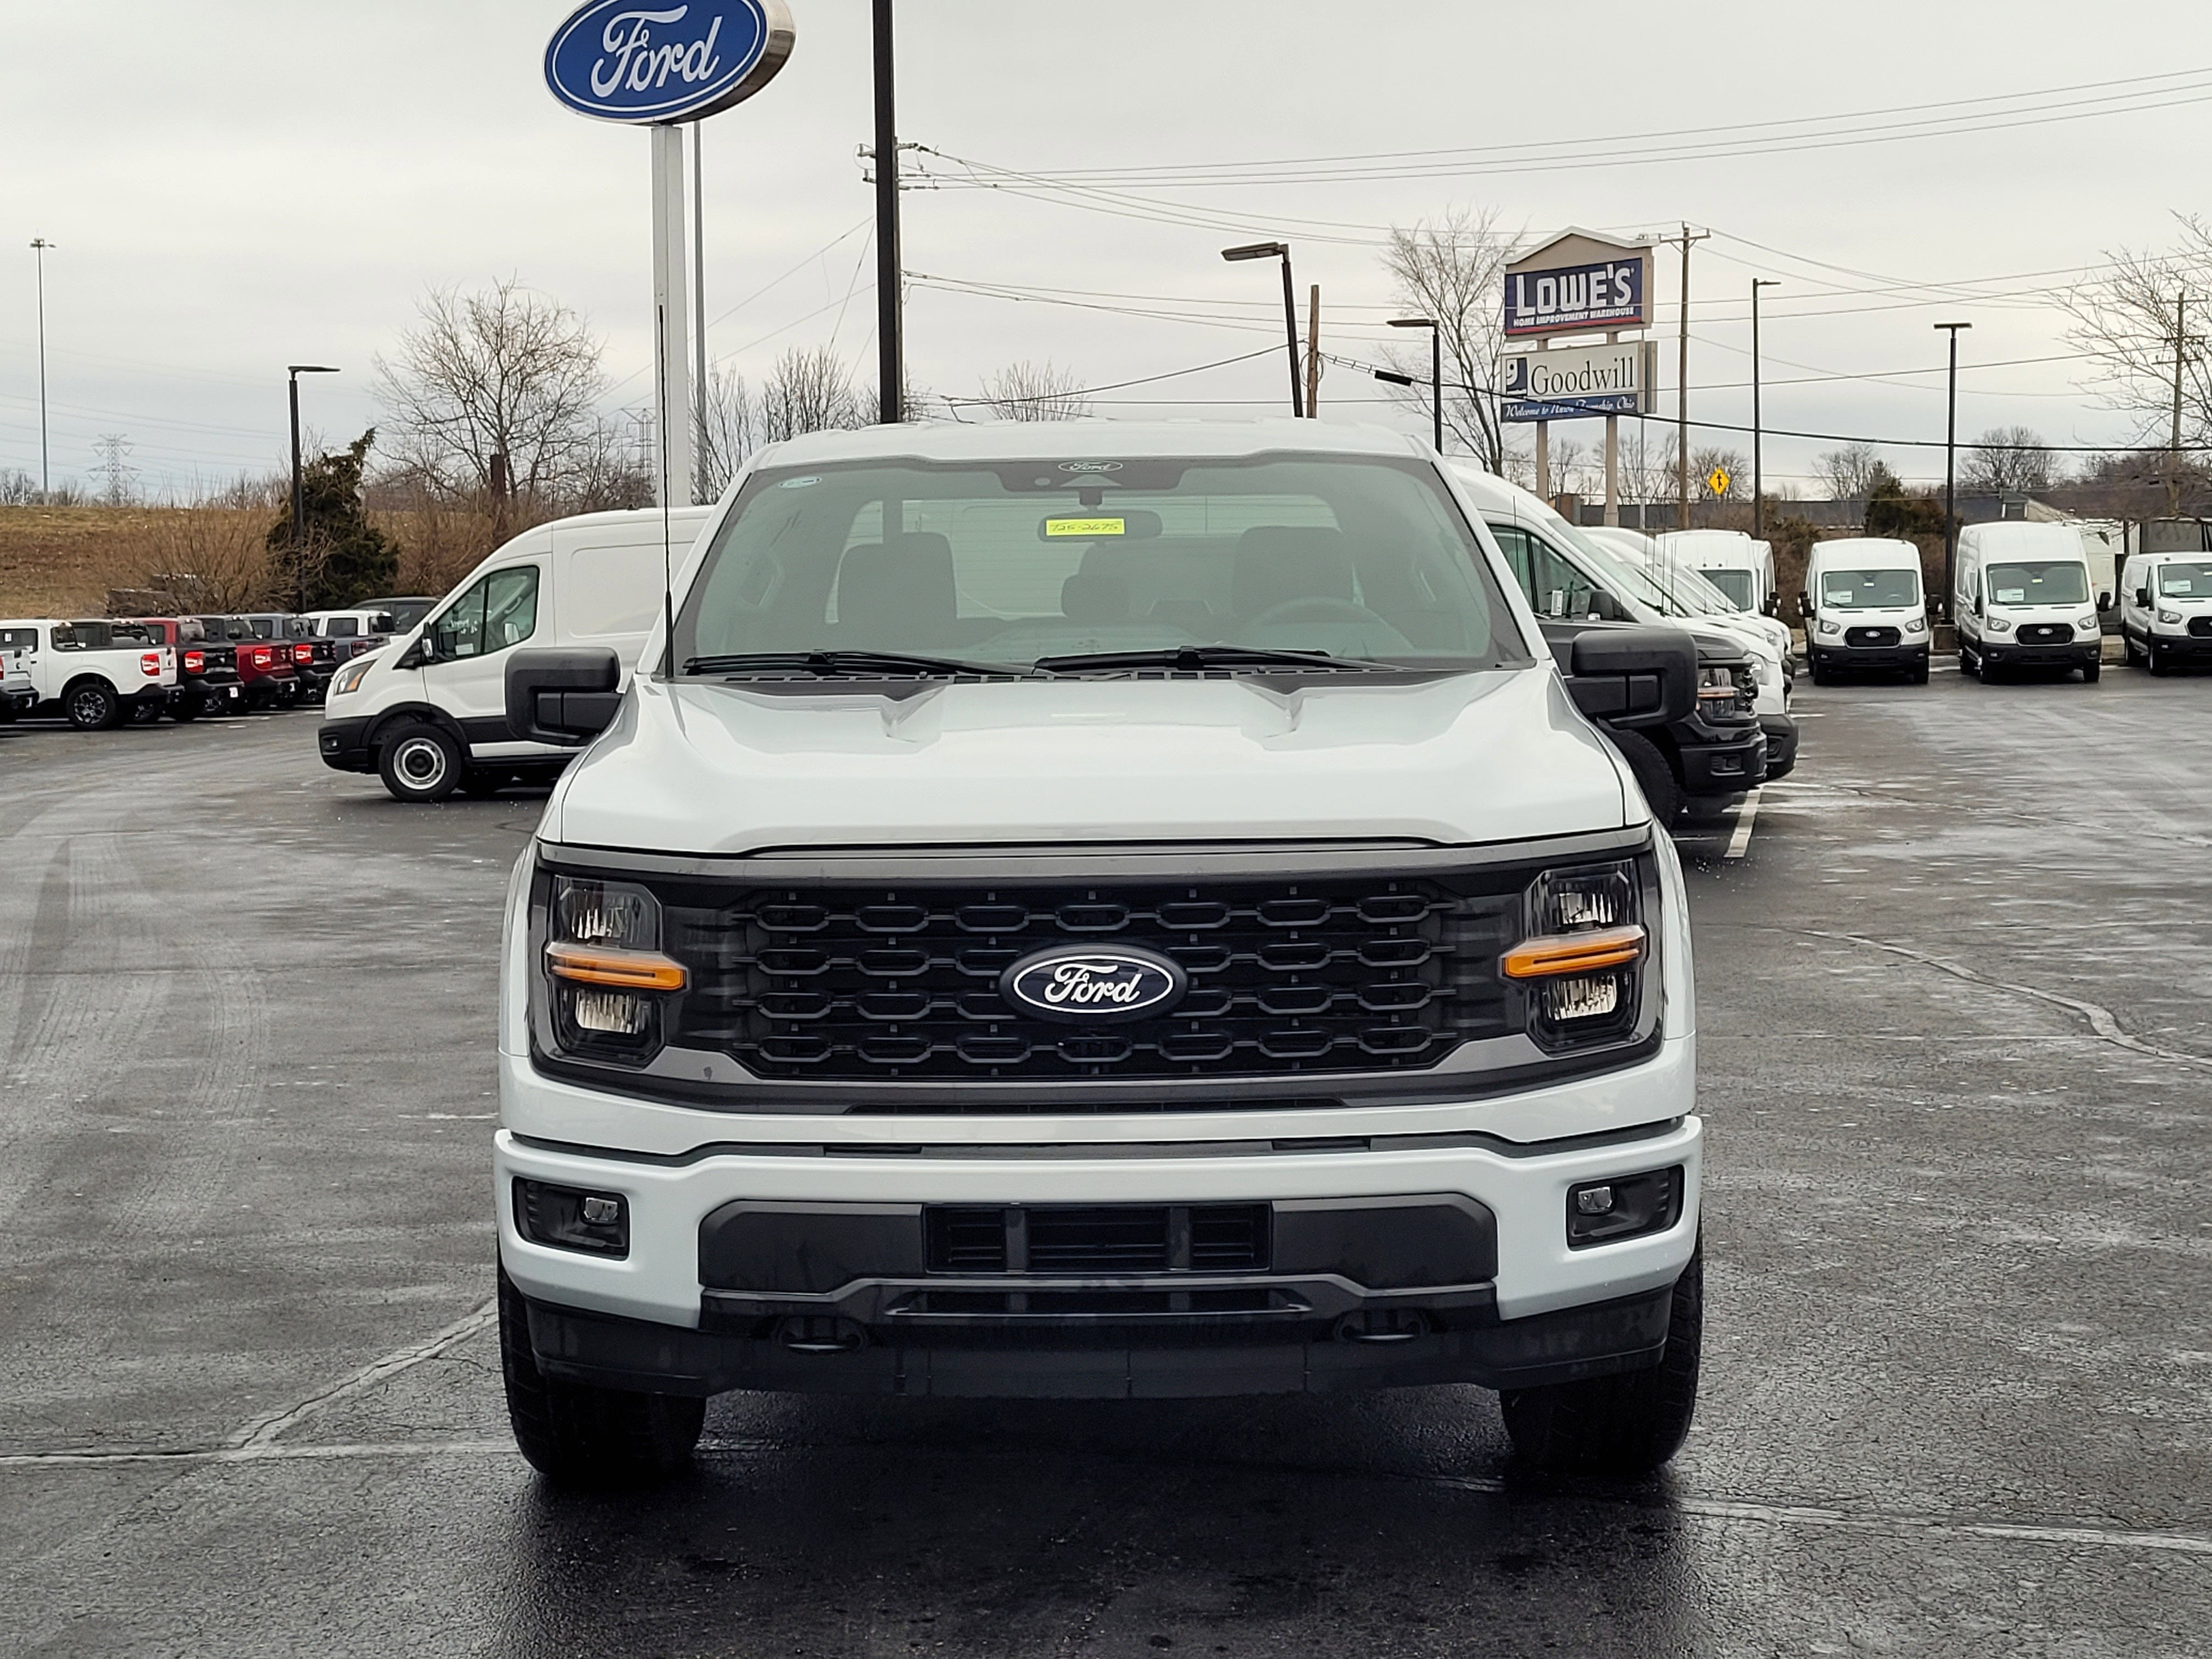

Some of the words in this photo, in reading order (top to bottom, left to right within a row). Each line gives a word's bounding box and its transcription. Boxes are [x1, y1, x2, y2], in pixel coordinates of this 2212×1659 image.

[591, 4, 723, 98] Ford
[1516, 263, 1633, 317] LOWE'S
[1513, 317, 1536, 328] HOME
[1536, 311, 1589, 325] IMPROVEMENT
[1590, 307, 1634, 319] WAREHOUSE
[1531, 357, 1635, 396] Goodwill
[1506, 404, 1540, 417] Welcome
[1541, 406, 1549, 415] to
[1617, 396, 1635, 409] Ohio
[1069, 461, 1111, 470] Ford
[1044, 963, 1144, 1003] Ford
